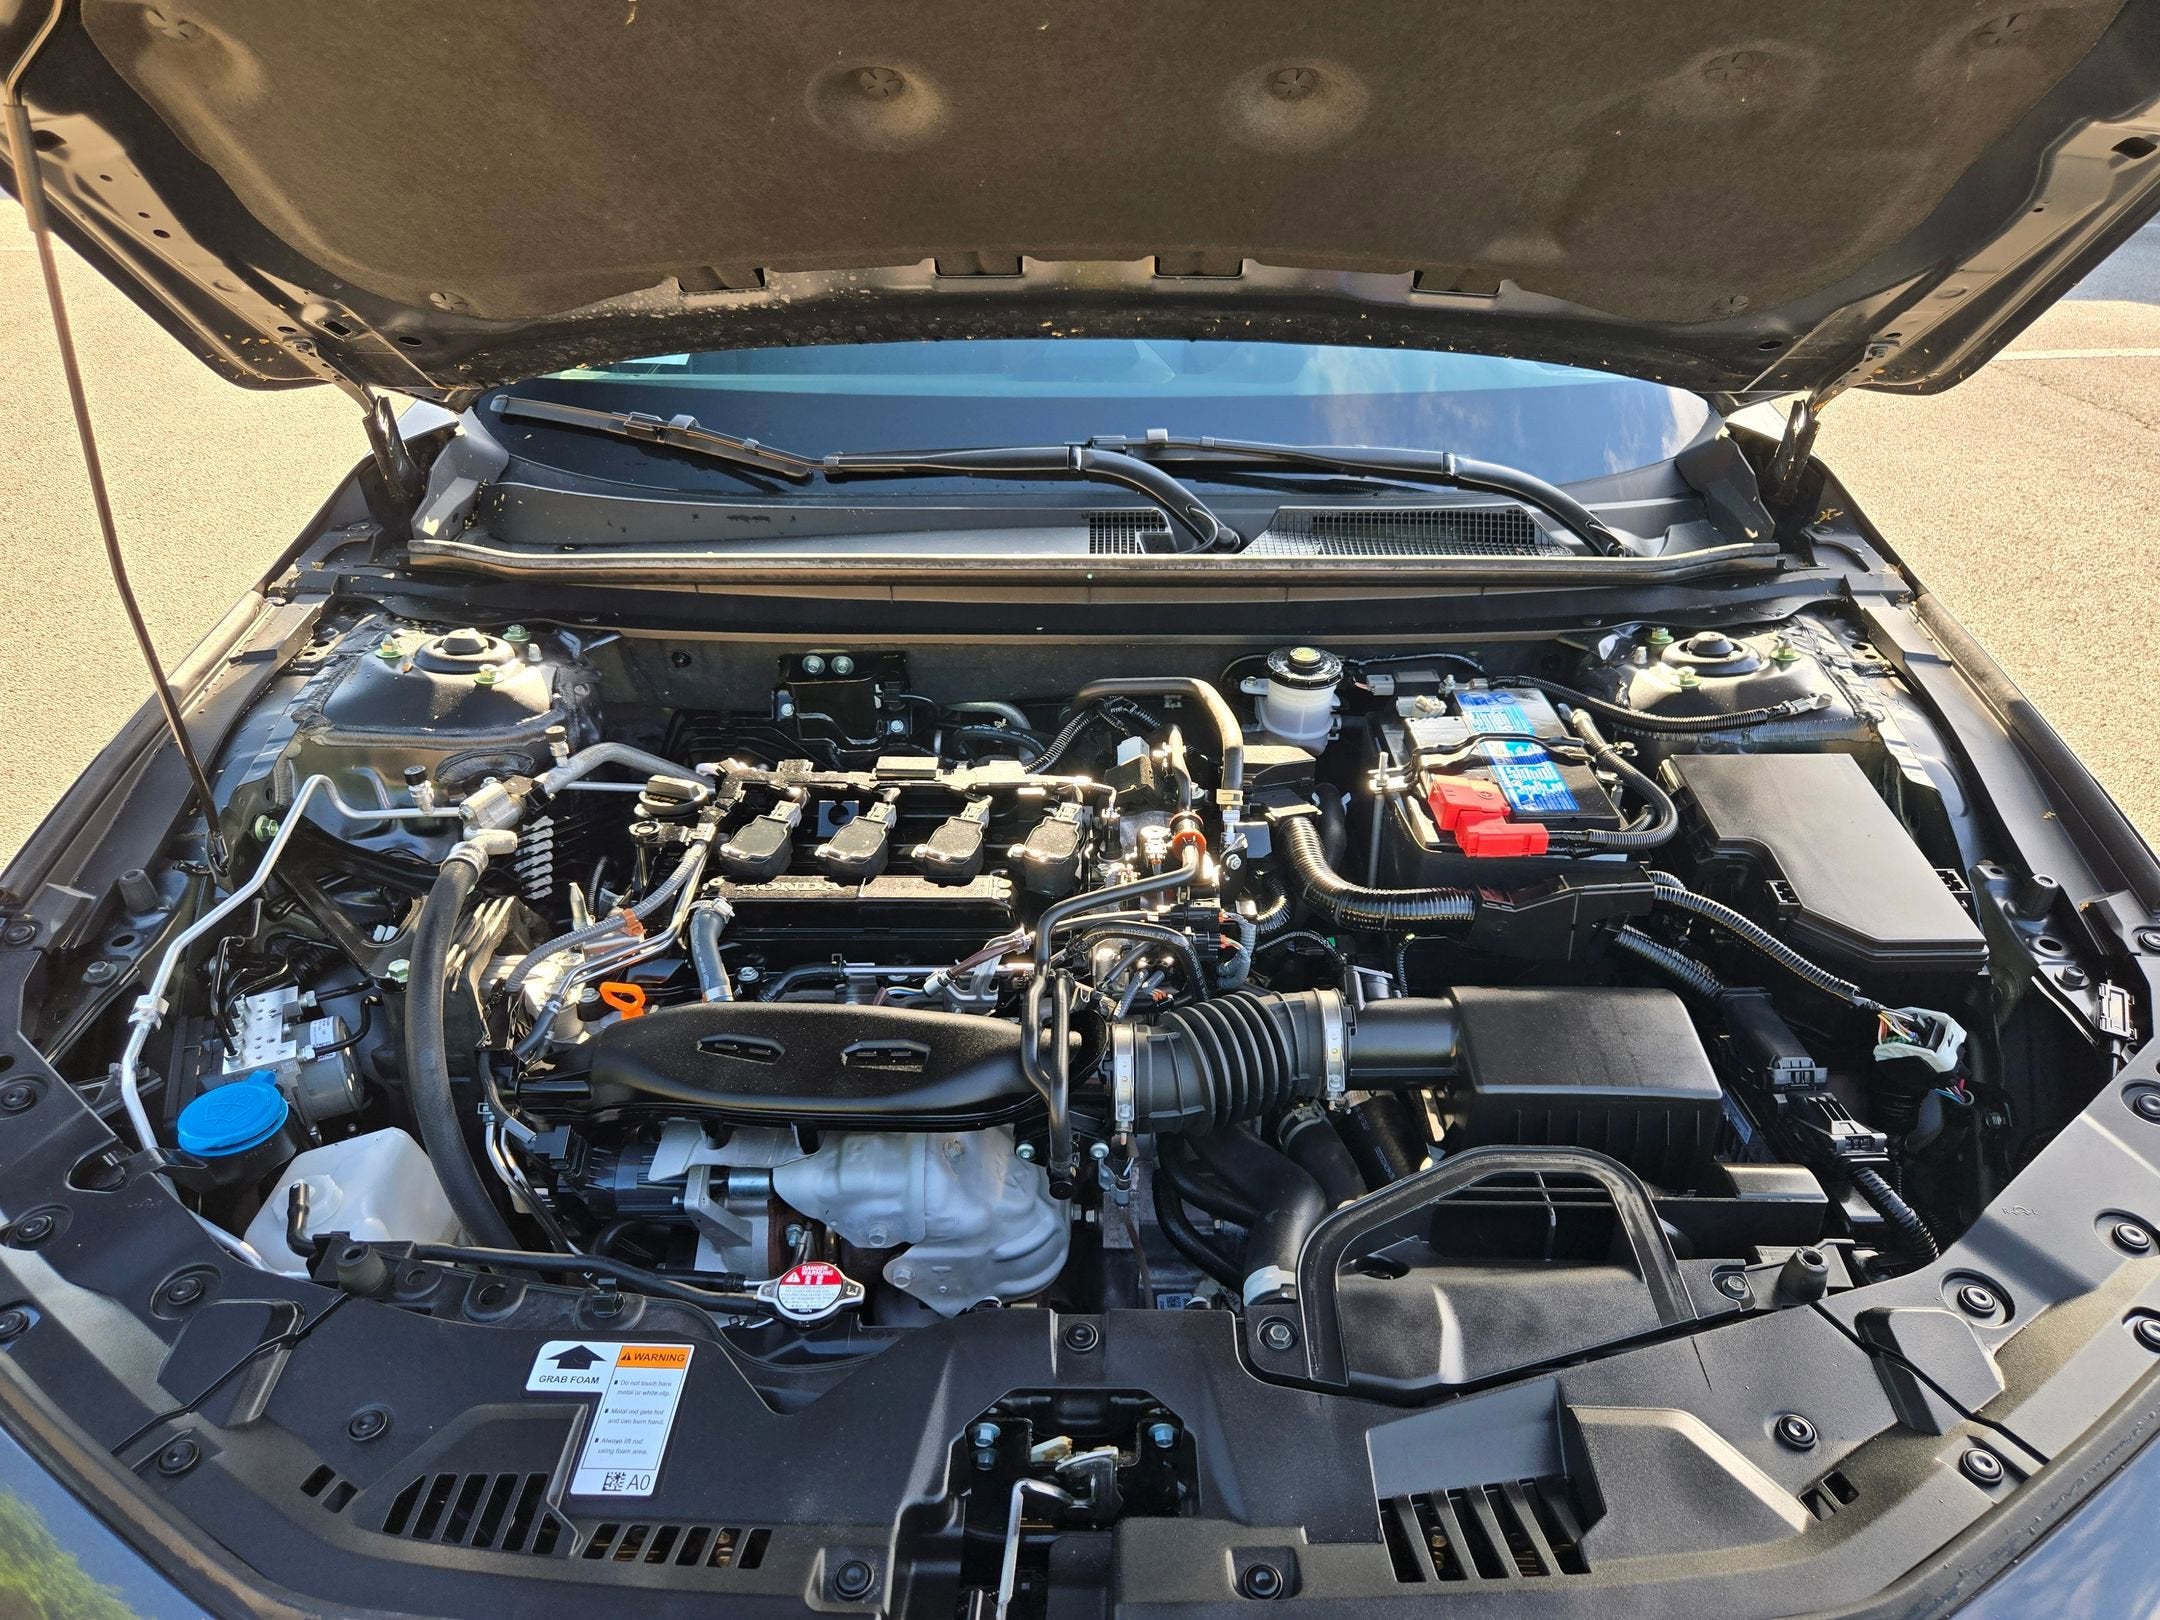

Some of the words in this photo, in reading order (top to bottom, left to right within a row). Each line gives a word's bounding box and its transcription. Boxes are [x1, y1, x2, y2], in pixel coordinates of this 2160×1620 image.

[634, 1352, 686, 1362] WARNING
[538, 1375, 568, 1383] GRAB
[569, 1376, 600, 1384] FOAM
